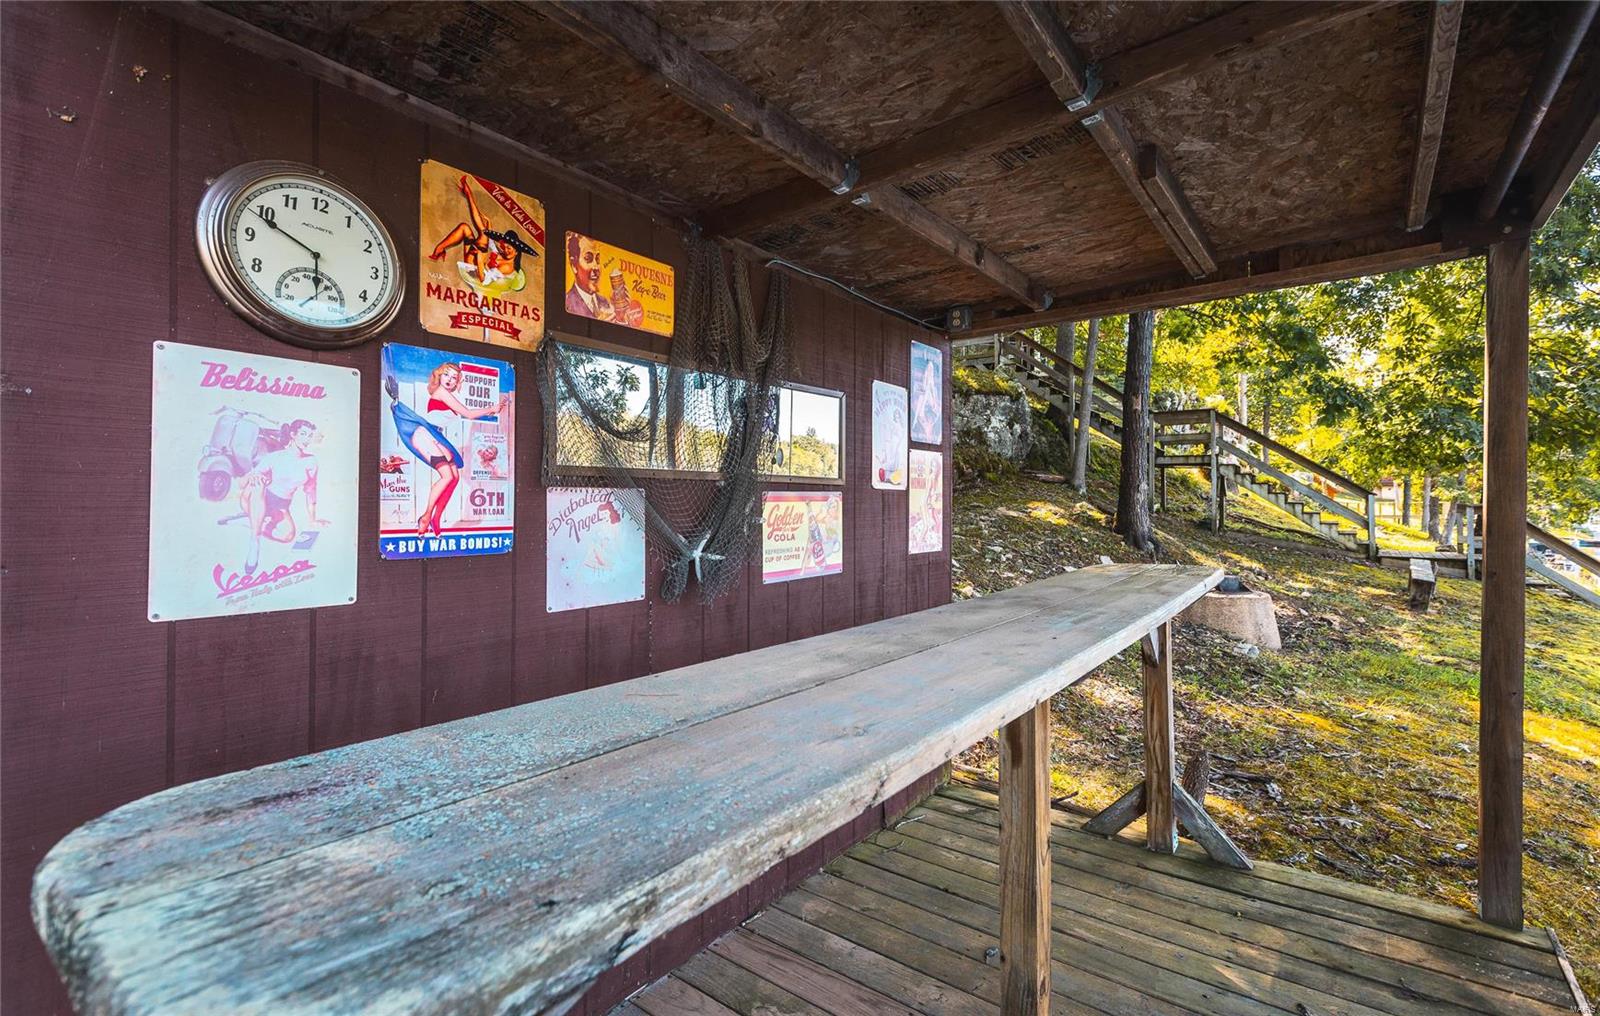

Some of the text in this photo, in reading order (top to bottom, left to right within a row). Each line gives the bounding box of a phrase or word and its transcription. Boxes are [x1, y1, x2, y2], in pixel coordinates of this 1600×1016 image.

[282, 194, 298, 211] 11
[312, 196, 330, 215] 12
[257, 204, 275, 222] 10
[345, 215, 352, 229] 1
[244, 226, 256, 242] 9
[363, 239, 373, 254] 2
[251, 257, 263, 273] 8
[619, 259, 673, 287] DUQUESNE
[291, 275, 300, 283] 20
[370, 266, 379, 281] 3
[359, 289, 369, 303] 4
[426, 282, 541, 322] MARGARITAS
[461, 314, 513, 333] ESPECIAL
[200, 361, 327, 399] Belissima
[464, 374, 496, 387] SUPPORT
[468, 385, 491, 399] OUR
[465, 398, 495, 409] TROOPS!
[389, 485, 410, 493] GUNS
[469, 488, 505, 507] 6TH
[473, 508, 505, 516] WAR LOAN
[549, 491, 613, 536] Diabolical
[565, 509, 604, 543] Angel
[767, 504, 804, 537] Golden
[399, 536, 503, 553] BUY WAR BONDS!
[774, 533, 796, 542] COLA
[783, 553, 801, 561] COFFEE
[212, 559, 317, 599] Vespa
